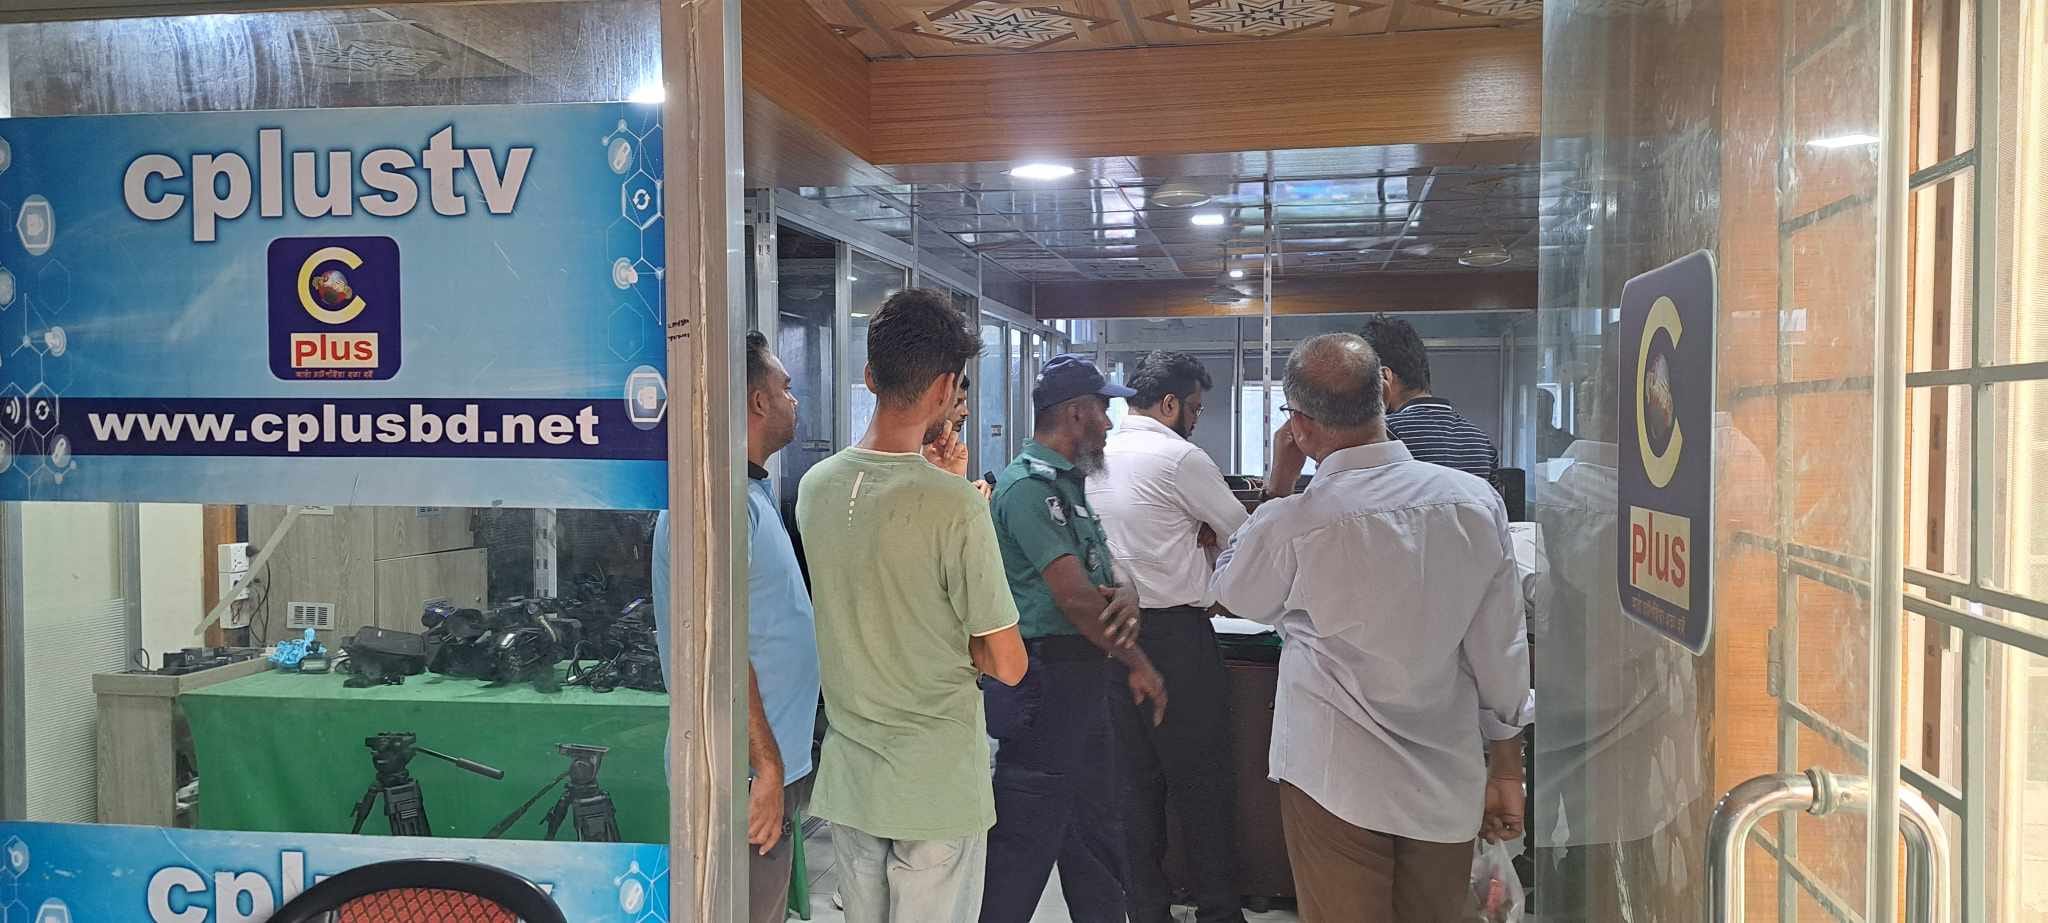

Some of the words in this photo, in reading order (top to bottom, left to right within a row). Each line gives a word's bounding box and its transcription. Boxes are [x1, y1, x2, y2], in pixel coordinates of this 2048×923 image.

[124, 125, 533, 242] cplustv
[297, 246, 367, 324] C
[295, 334, 373, 366] plus
[88, 402, 600, 452] www.cplusbd.net
[1637, 296, 1682, 488] C
[1632, 512, 1686, 588] plus
